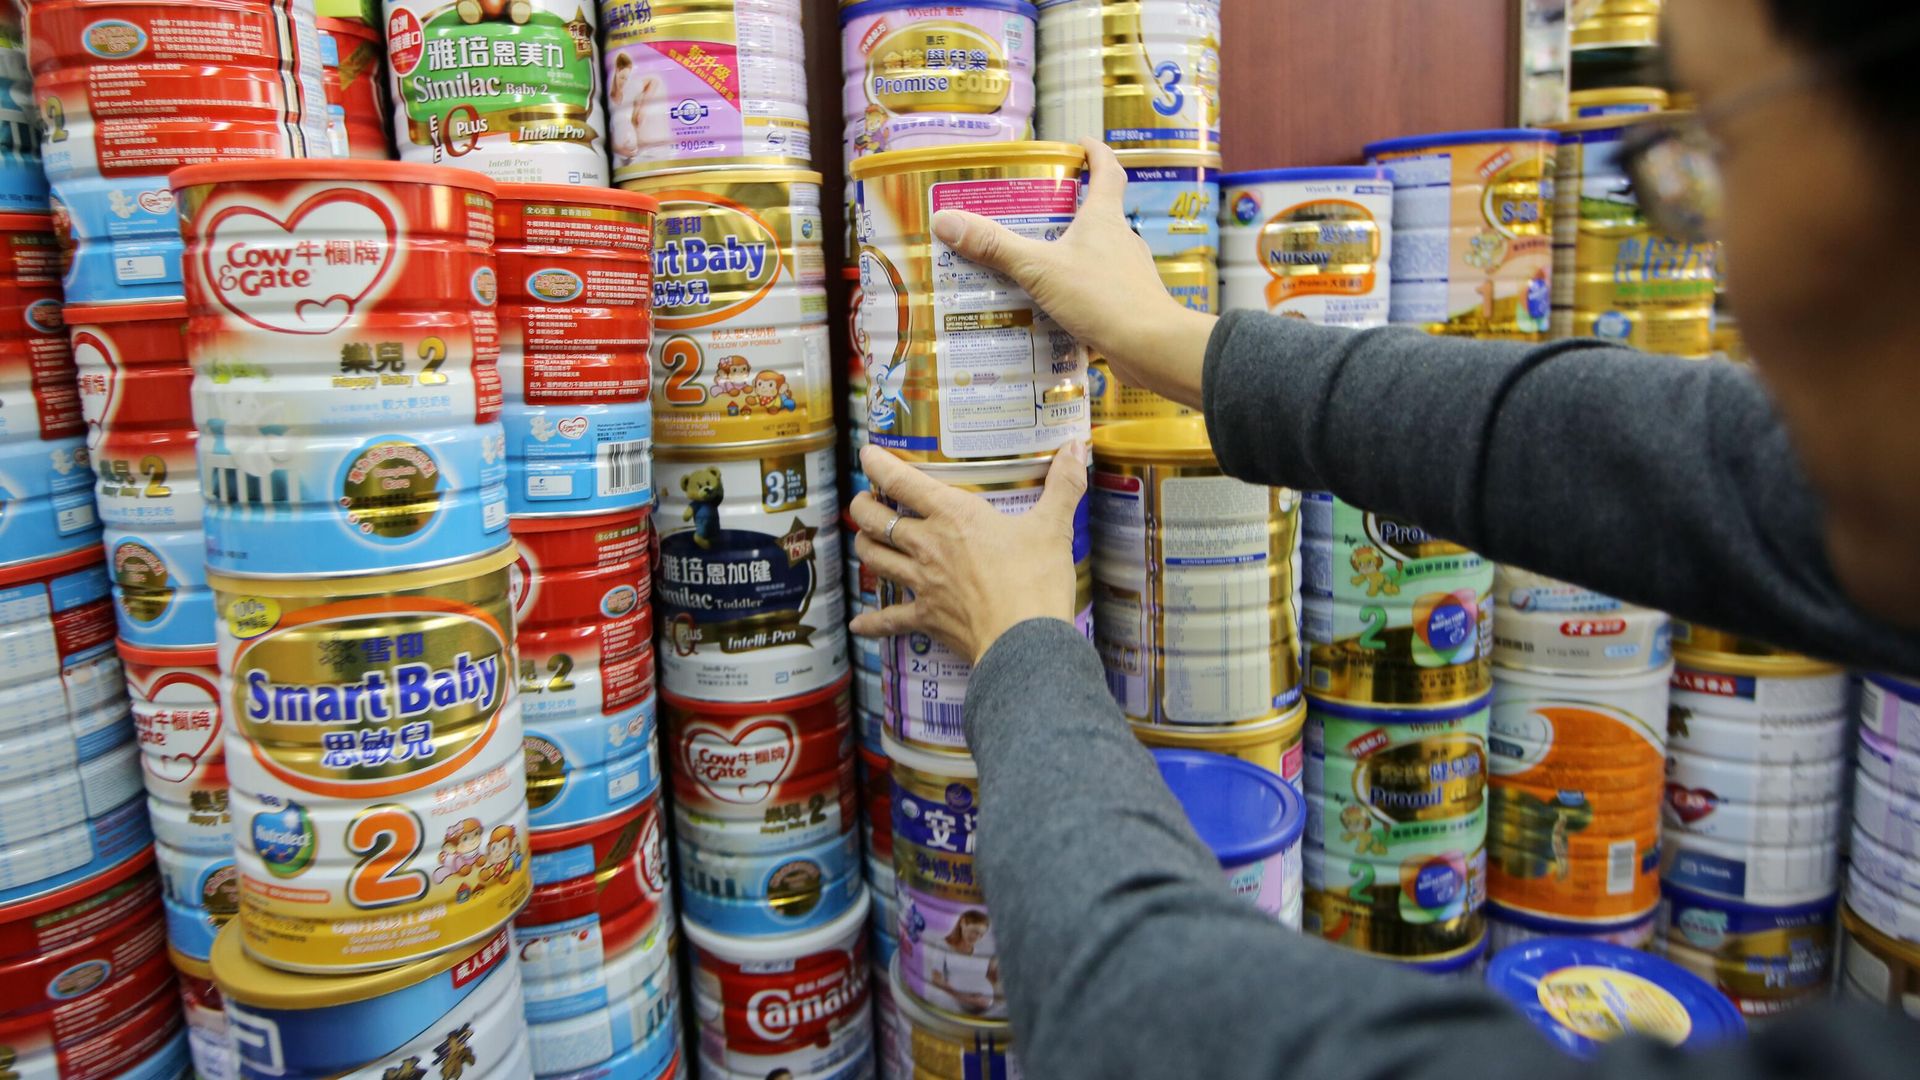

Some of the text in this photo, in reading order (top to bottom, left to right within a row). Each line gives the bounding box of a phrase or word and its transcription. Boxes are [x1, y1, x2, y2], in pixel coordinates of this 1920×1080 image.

[906, 7, 941, 19] Wyeth
[426, 36, 565, 71] 雅培恩美力
[687, 44, 731, 82] 新升級
[412, 72, 548, 103] Similac Baby 2
[874, 75, 1001, 95] Promise GOLD
[1152, 60, 1184, 116] 3
[429, 114, 442, 163] EYE
[442, 104, 488, 157] Q PLUS
[1136, 171, 1162, 180] Wyeth
[665, 216, 701, 236] 雪印
[1502, 201, 1537, 223] S-26
[227, 240, 381, 267] Cow 牛欄牌
[683, 235, 765, 280] Baby
[238, 267, 311, 296] Gate
[341, 336, 449, 385] 樂兒 2
[661, 334, 706, 406] 2
[140, 455, 171, 497] 2
[765, 470, 785, 508] 3
[1381, 521, 1432, 544] Pro
[662, 556, 772, 585] 雅培恩加健
[714, 598, 763, 609] Toddler
[681, 629, 702, 640] PLUS
[728, 630, 797, 650] Intelli-Pro
[1359, 605, 1388, 649] 2
[361, 632, 424, 663] 雪印
[547, 653, 575, 692] 2
[912, 661, 928, 673] 2x
[247, 652, 499, 724] Smart Baby
[155, 711, 211, 731] 牛欄牌
[322, 722, 434, 768] 思敏兒
[699, 747, 785, 766] Cow 牛欄牌
[809, 793, 827, 825] 2
[345, 803, 430, 910] 2
[1349, 864, 1376, 903] 2
